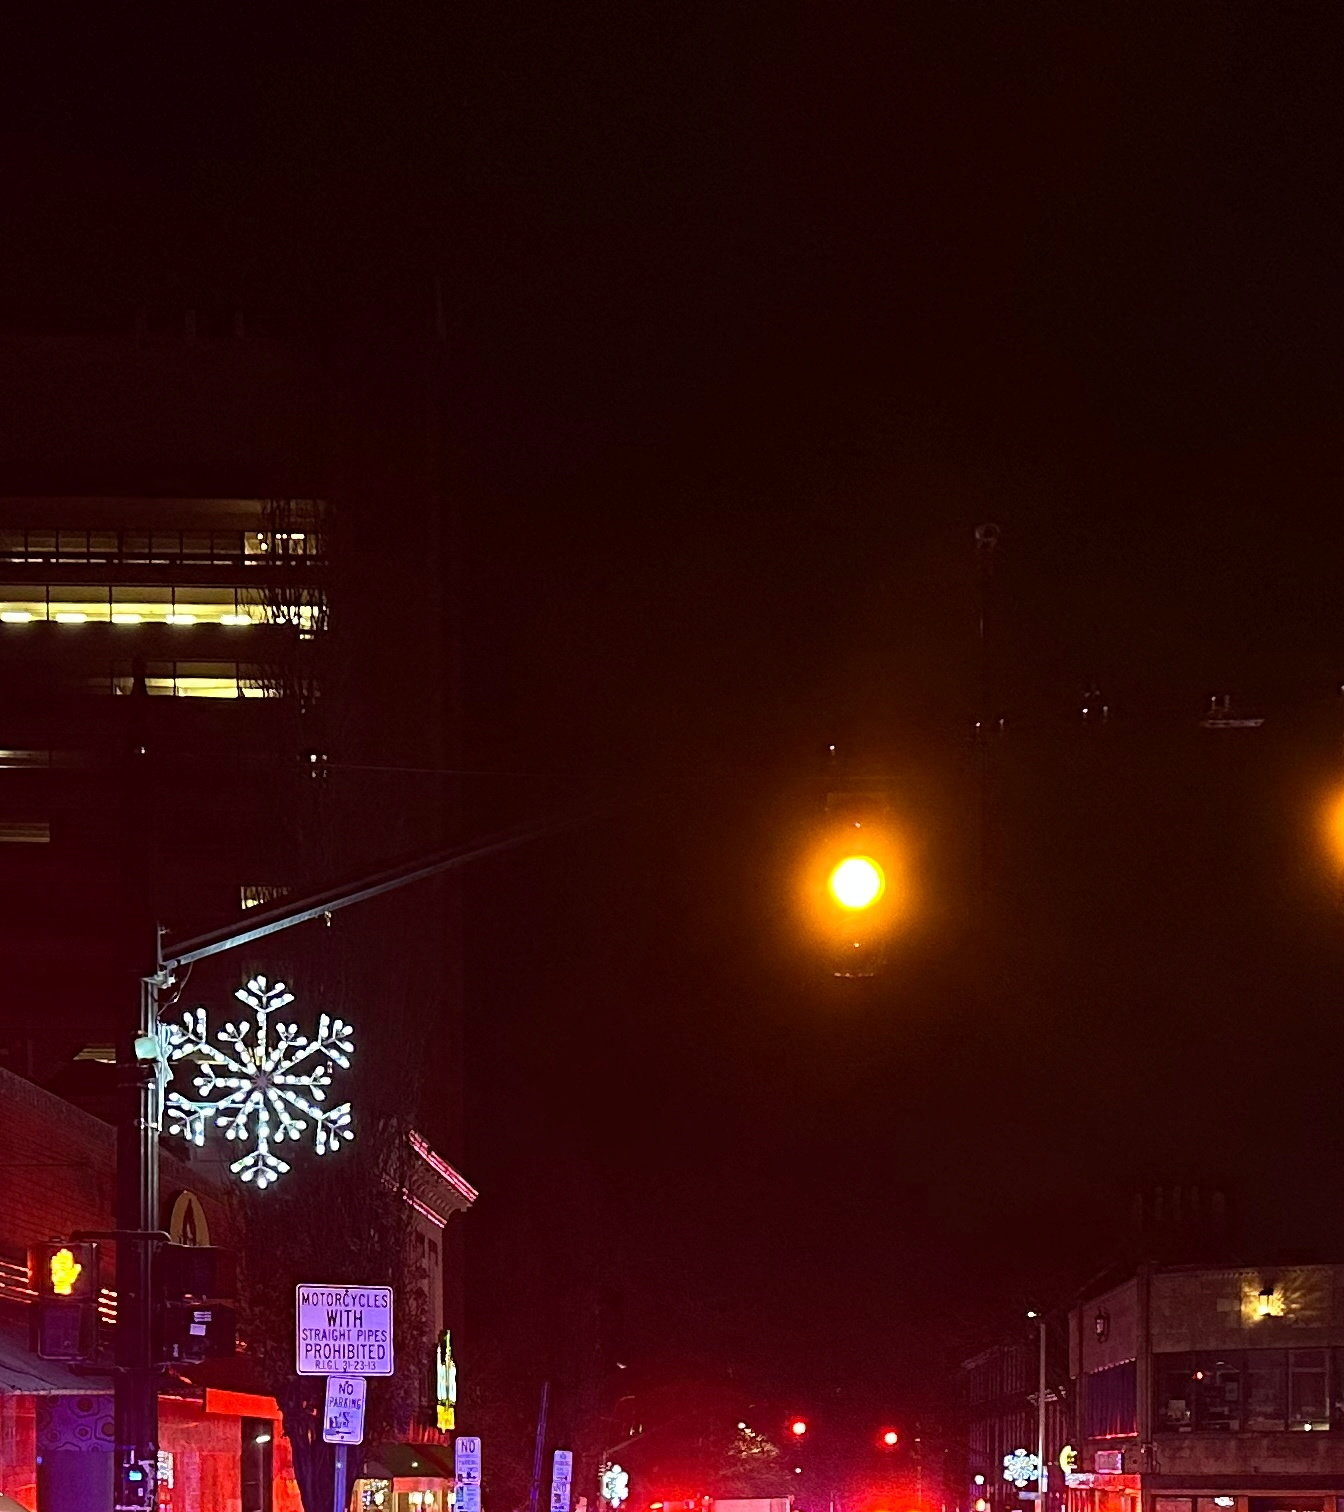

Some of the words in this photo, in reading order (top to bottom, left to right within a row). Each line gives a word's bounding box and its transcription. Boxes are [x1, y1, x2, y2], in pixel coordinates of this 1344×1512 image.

[301, 1291, 388, 1309] MOTORCYCLES
[326, 1309, 363, 1328] WITH
[301, 1328, 351, 1342] STRAIGHT
[356, 1329, 388, 1342] PIPES
[305, 1343, 386, 1360] PROHIBITED
[338, 1383, 354, 1396] NO
[461, 1440, 476, 1454] NO
